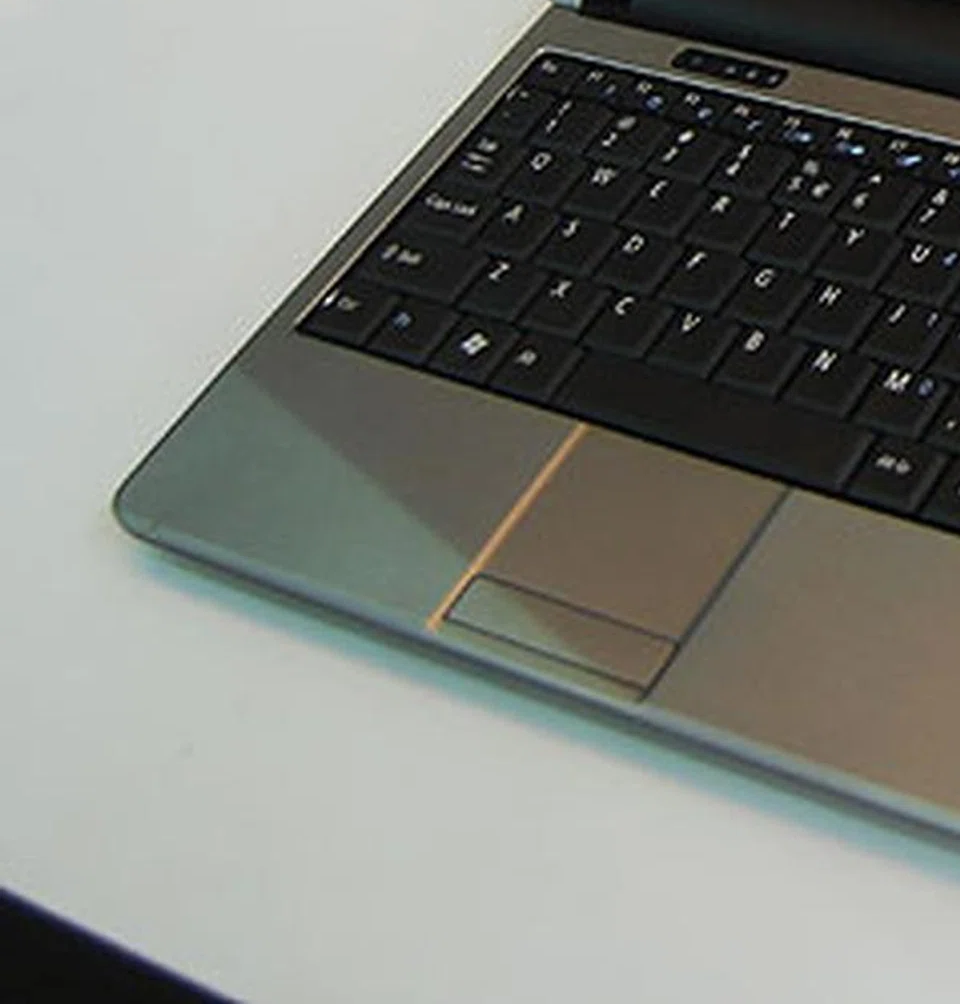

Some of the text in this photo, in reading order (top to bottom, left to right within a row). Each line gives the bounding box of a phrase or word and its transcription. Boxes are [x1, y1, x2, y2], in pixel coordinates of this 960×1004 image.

[530, 152, 552, 171] Q
[591, 167, 617, 185] W
[503, 204, 523, 222] A
[711, 195, 731, 213] R
[778, 211, 795, 230] T
[622, 233, 645, 253] D
[846, 228, 865, 245] Y
[910, 244, 931, 263] U
[488, 262, 510, 281] Z
[754, 268, 774, 288] G
[550, 281, 572, 298] X
[818, 285, 842, 305] H
[614, 296, 635, 316] C
[681, 313, 701, 332] V
[744, 330, 765, 351] B
[812, 349, 837, 372] N
[883, 370, 911, 391] M
